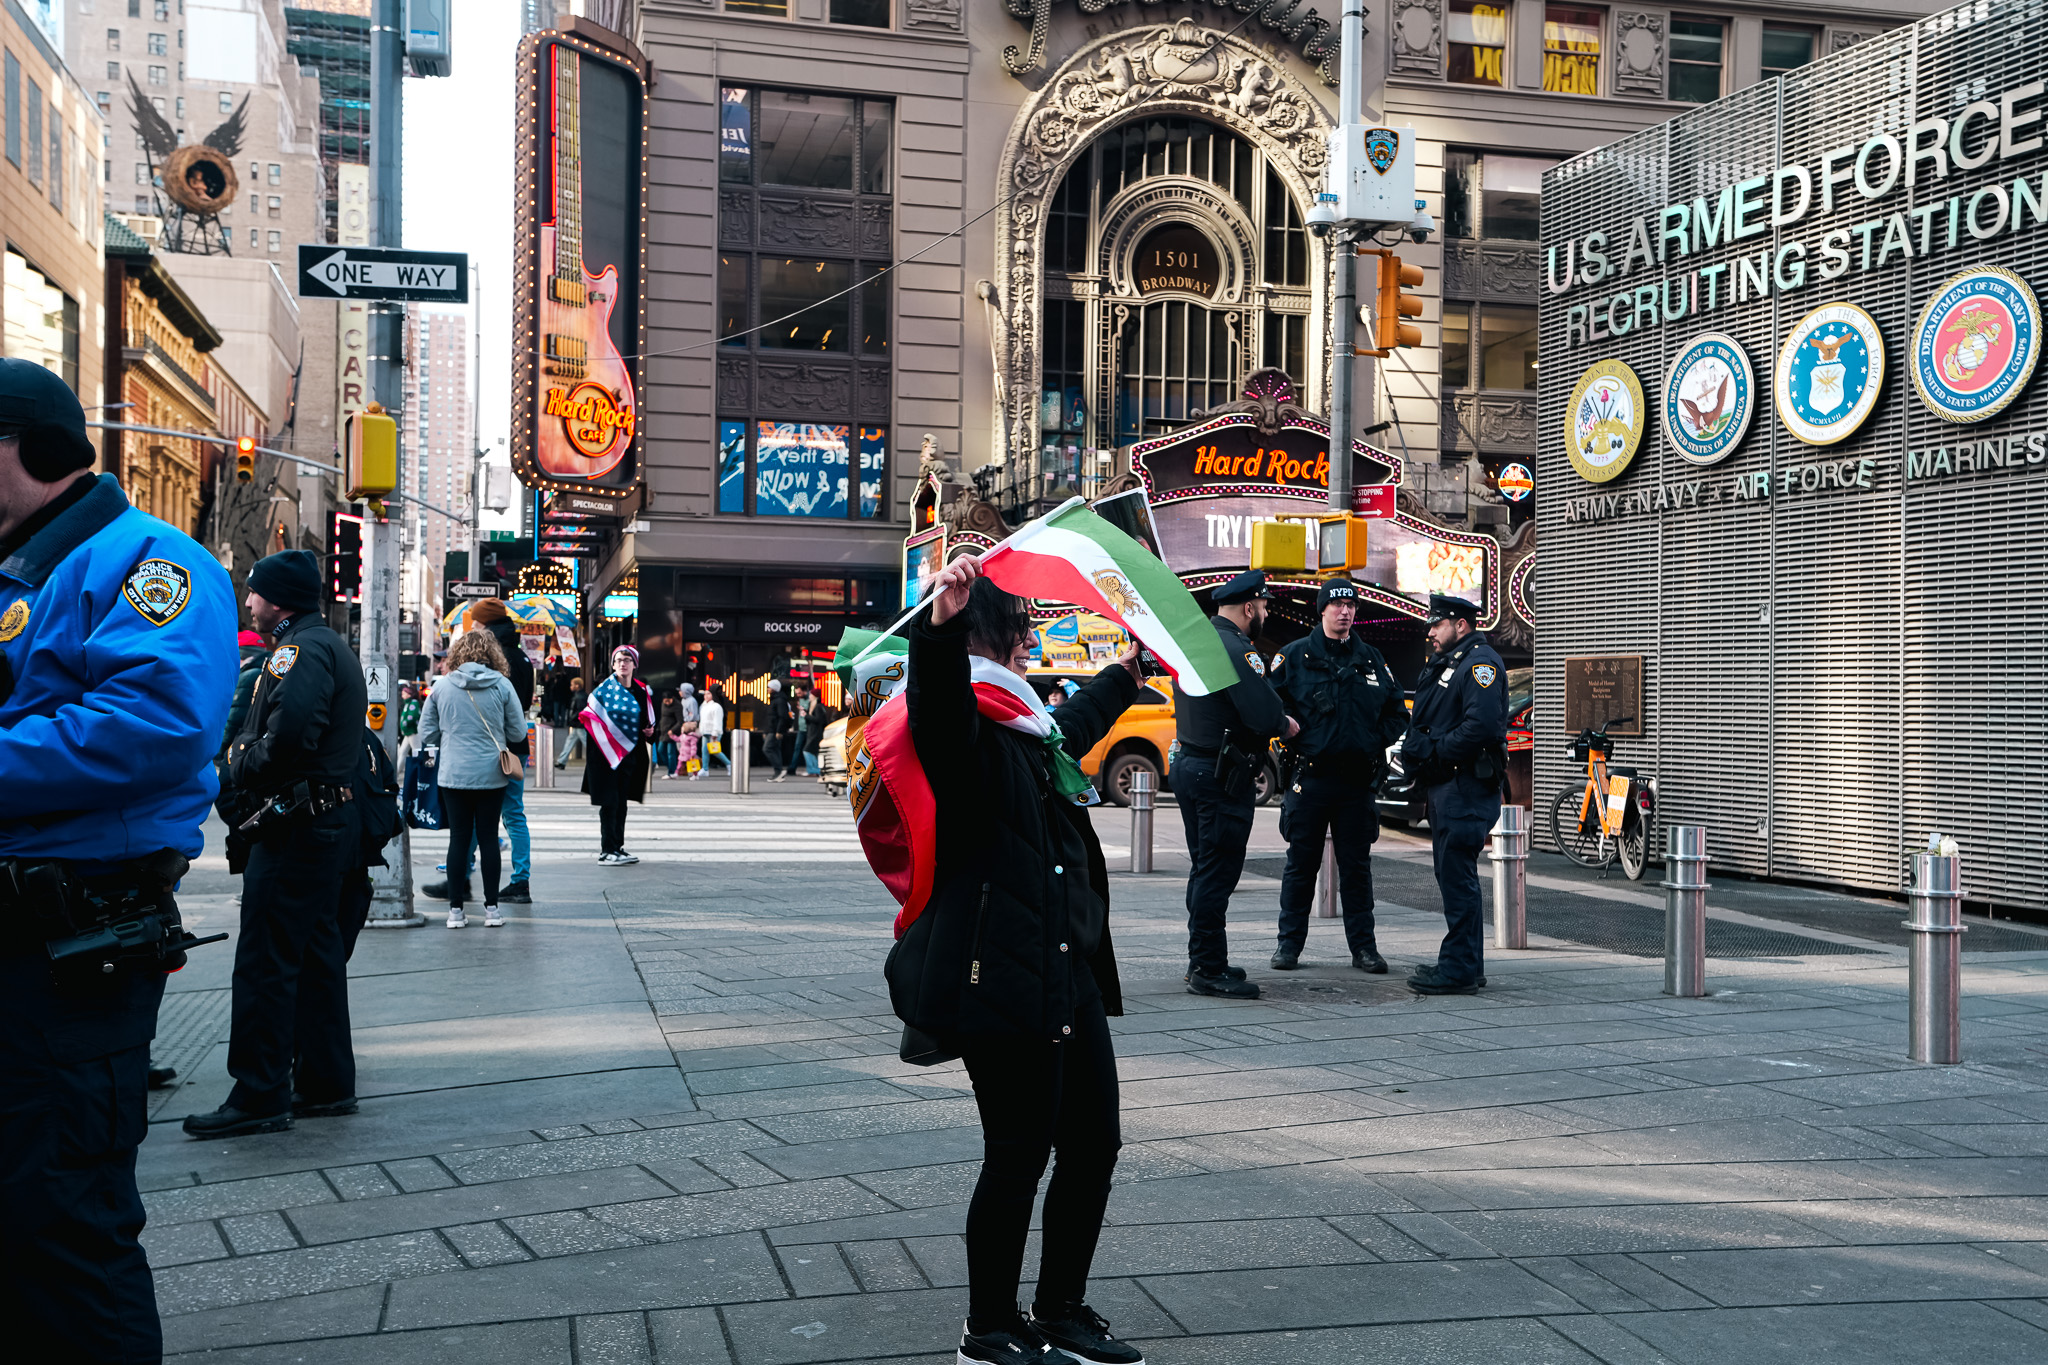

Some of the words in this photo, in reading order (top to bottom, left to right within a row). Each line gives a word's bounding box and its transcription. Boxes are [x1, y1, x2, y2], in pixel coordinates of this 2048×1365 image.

[1547, 231, 1615, 295] U.S.
[1621, 164, 1813, 276] ARMED
[1821, 82, 2048, 213] FORCE
[1155, 250, 1198, 269] 1501
[1566, 241, 1806, 348] RECRUITING
[1818, 171, 2048, 279] STATION
[325, 262, 373, 284] ONE
[396, 266, 447, 287] WAY
[1141, 276, 1211, 294] BROADWAY
[1815, 310, 1831, 324] OF
[1837, 308, 1858, 324] THE
[1860, 322, 1876, 343] AIR
[1921, 281, 1973, 357] DEPARTMENT
[1974, 281, 1989, 291] OF
[1988, 281, 2008, 297] THE
[2005, 291, 2029, 326] NAVY
[1669, 347, 1703, 404] DEPARTMENT
[1703, 345, 1715, 355] OF
[1717, 345, 1730, 360] THE
[1728, 356, 1745, 381] NAVY
[1923, 365, 1946, 400] UNITED
[1945, 395, 1977, 408] STATES
[1979, 372, 2014, 404] MARINE
[2010, 336, 2028, 373] CORPS
[1569, 366, 1605, 418] DEPARTMENT
[1608, 365, 1617, 373] OF
[1619, 368, 1632, 384] THE
[1630, 385, 1641, 412] ARMY
[546, 388, 595, 422] Hard
[593, 397, 635, 437] Rock
[1669, 413, 1689, 447] UNITED
[1686, 441, 1713, 454] STATES
[1713, 436, 1725, 450] OF
[1723, 395, 1746, 441] AMERICA
[1809, 412, 1842, 425] MCMXLVII
[579, 428, 606, 443] CAFE
[1567, 425, 1581, 464] UNITED
[1580, 463, 1606, 477] STATES
[1607, 465, 1617, 476] OF
[1618, 422, 1641, 465] AMERICA
[1193, 445, 1265, 477] Hard
[1265, 448, 1331, 487] Rock
[1594, 455, 1609, 463] 1775
[1357, 487, 1384, 496] STOPPING
[1563, 493, 1621, 523] ARMY
[1637, 482, 1703, 514] NAVY
[1732, 471, 1771, 501] AIR
[1783, 458, 1876, 493] FORCE
[1906, 432, 2048, 480] MARINES
[572, 499, 614, 511] SPECTACOLOR
[1205, 514, 1244, 549] TRY
[138, 562, 173, 572] POLICE
[533, 574, 558, 587] 1501
[127, 587, 142, 603] CITY
[138, 601, 152, 614] OF
[163, 602, 179, 618] NEW
[174, 586, 188, 605] YORK
[455, 586, 469, 594] ONE
[477, 586, 493, 594] WAY
[1329, 587, 1354, 599] NYPD
[764, 622, 792, 633] ROCK
[794, 622, 822, 634] SHOP
